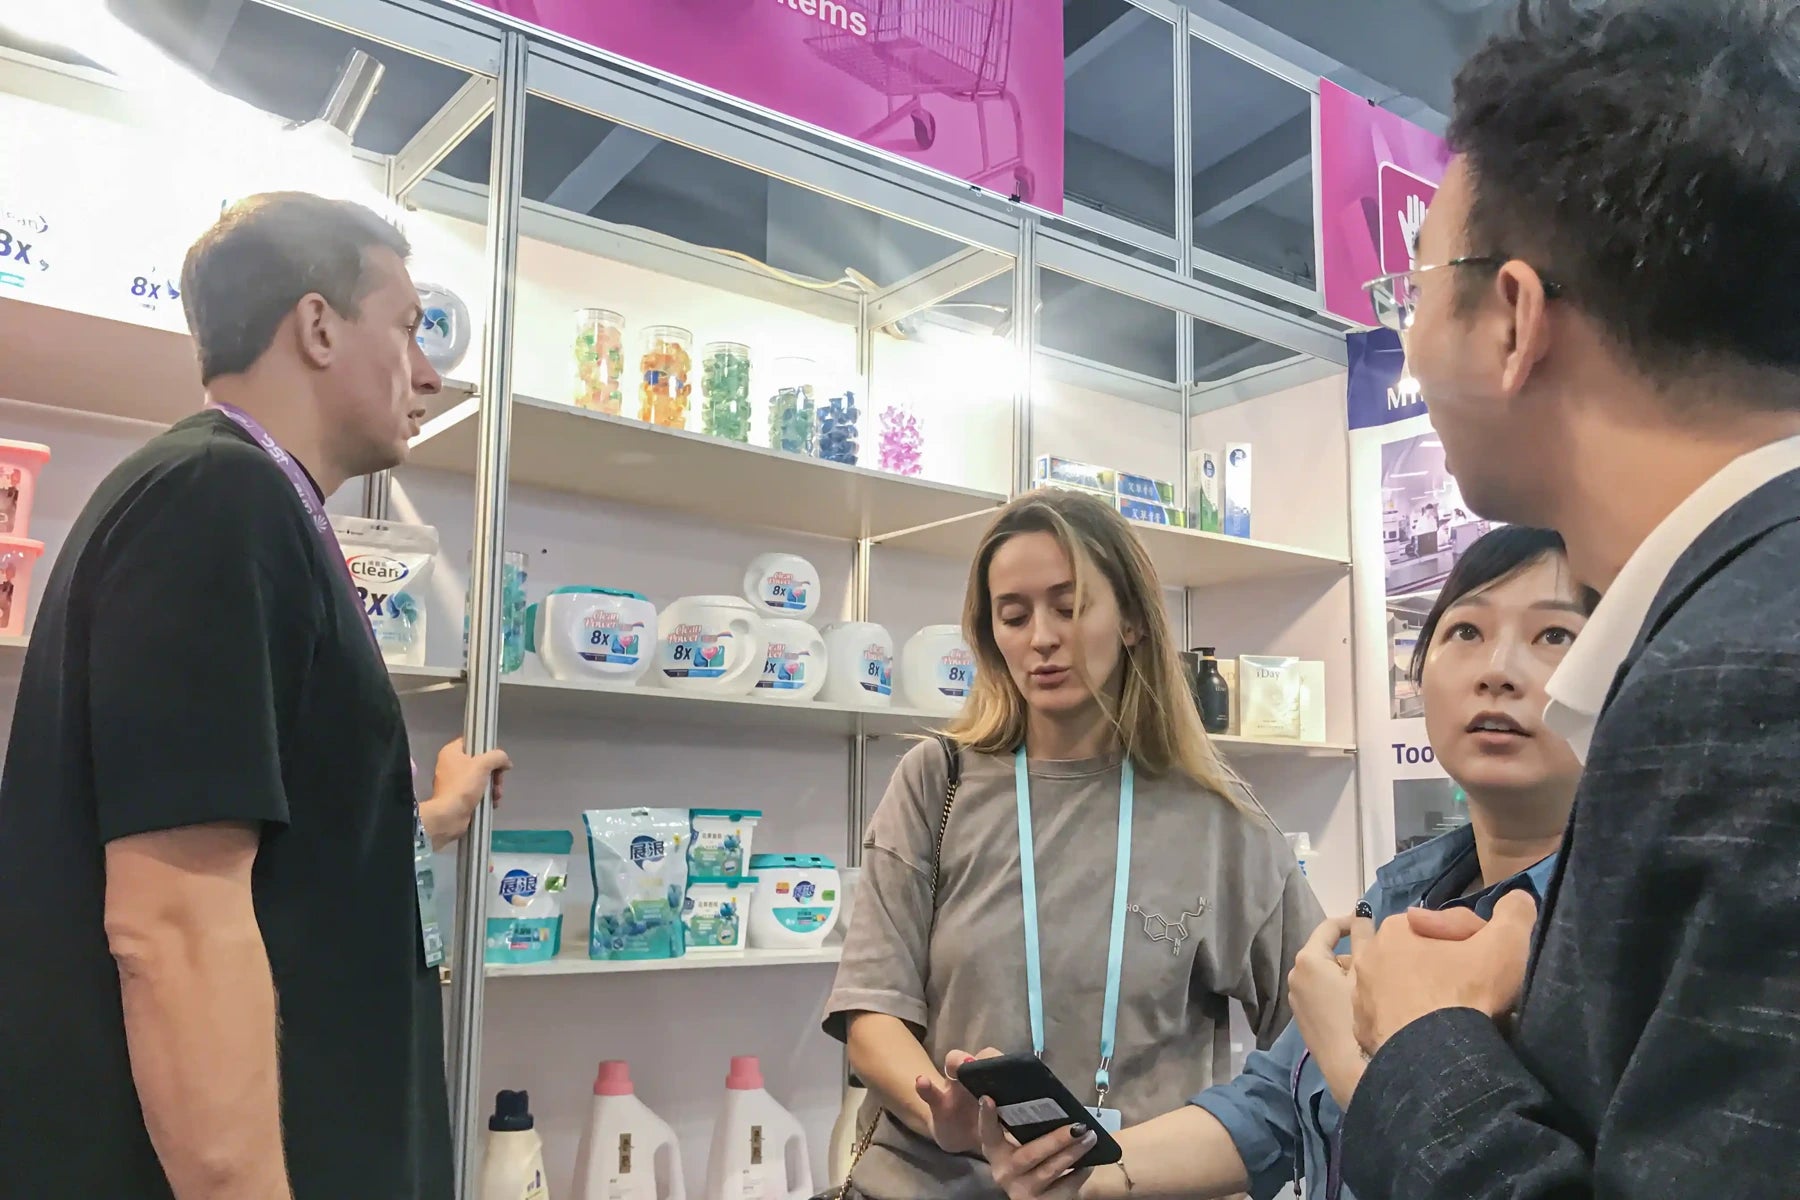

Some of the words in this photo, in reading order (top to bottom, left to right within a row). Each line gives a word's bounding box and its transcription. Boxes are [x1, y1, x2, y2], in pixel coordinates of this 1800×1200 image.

[777, 0, 867, 36] ems
[131, 276, 161, 299] 8x
[351, 561, 399, 578] Clean
[772, 585, 787, 596] 8x
[590, 630, 609, 645] 8x
[673, 645, 692, 660] 8x
[868, 662, 880, 676] 8x
[949, 667, 965, 681] 8x
[1256, 669, 1280, 680] iDay
[1392, 744, 1434, 764] Too
